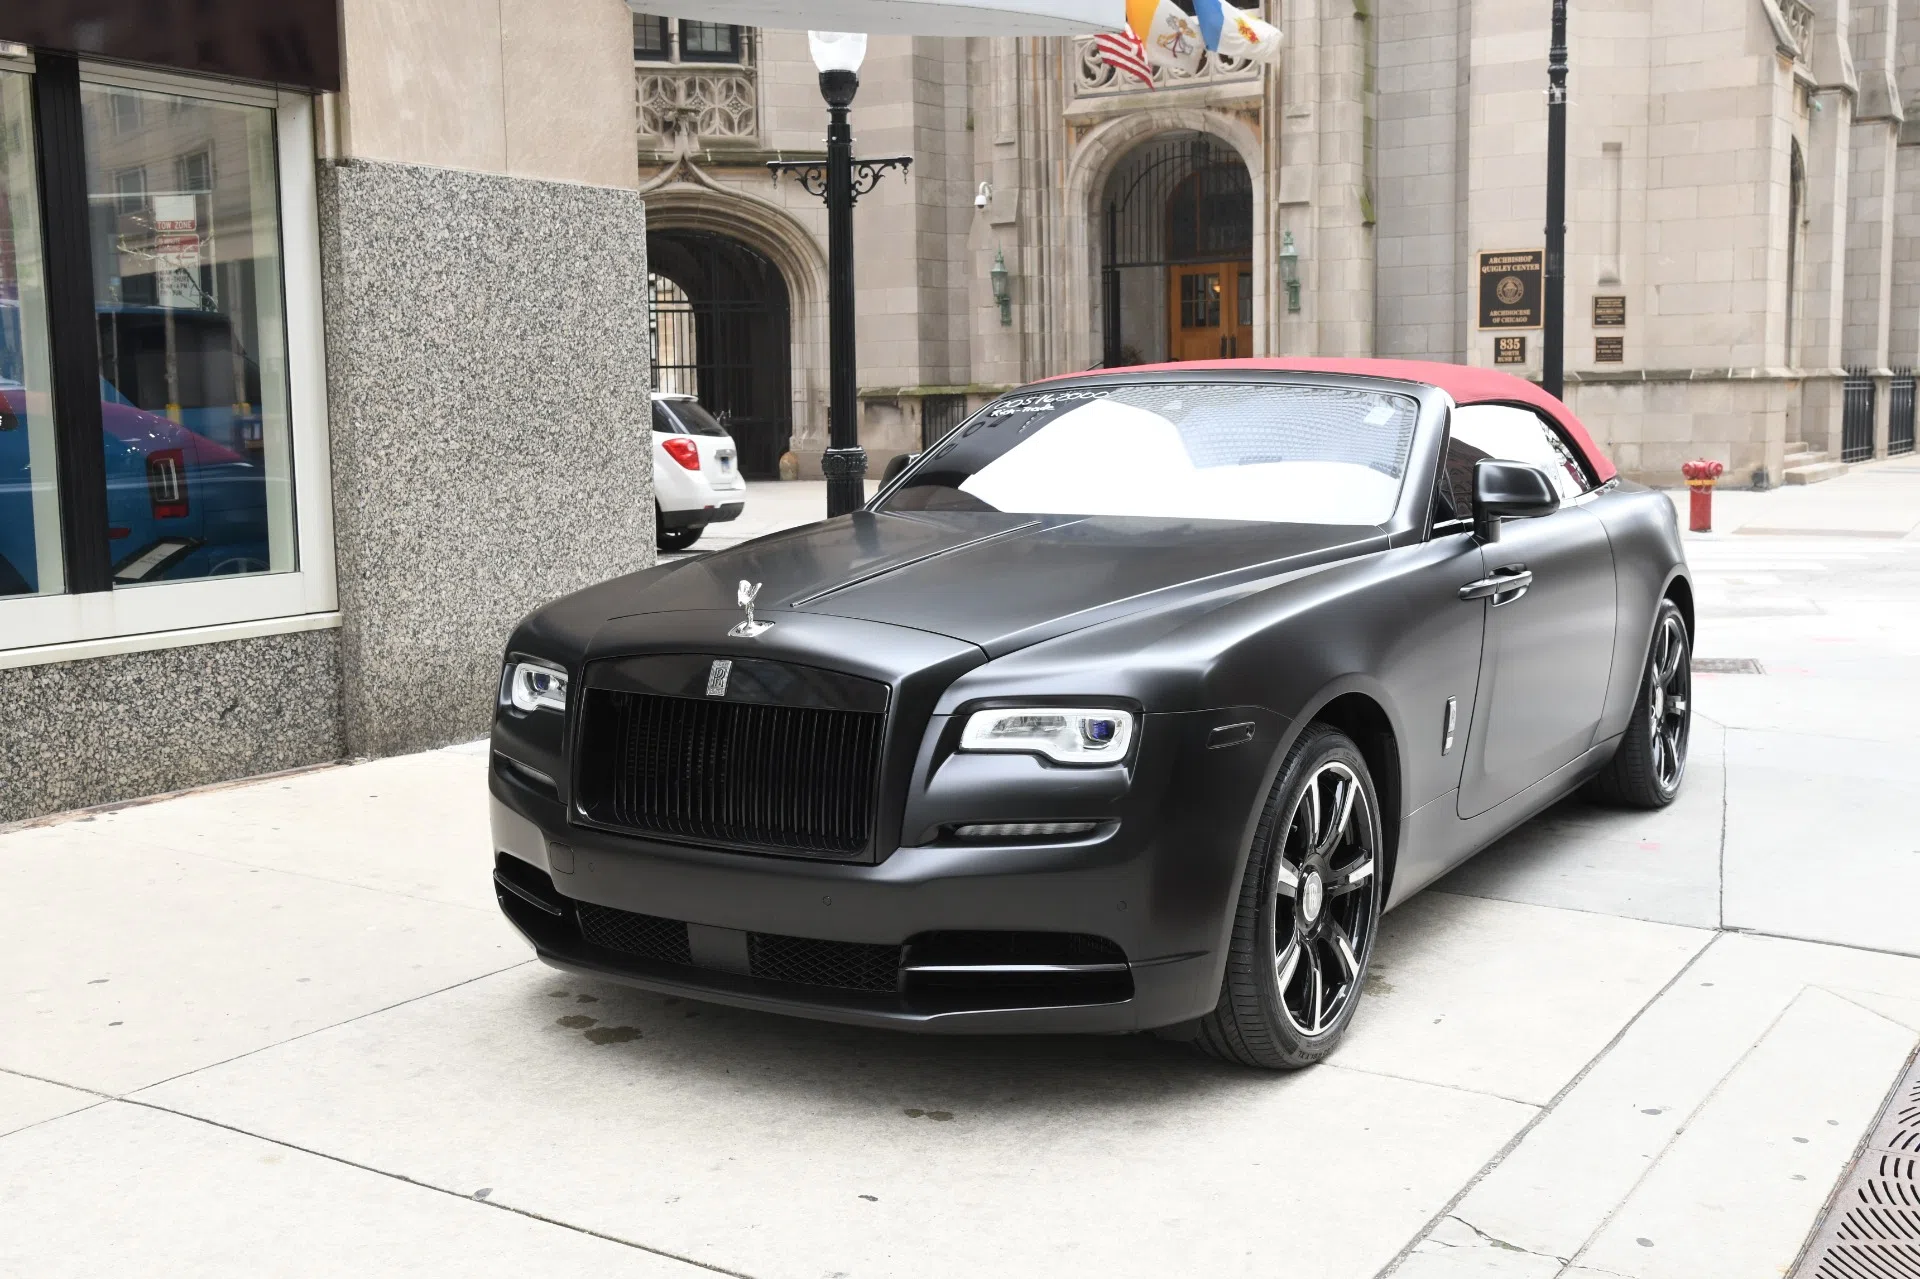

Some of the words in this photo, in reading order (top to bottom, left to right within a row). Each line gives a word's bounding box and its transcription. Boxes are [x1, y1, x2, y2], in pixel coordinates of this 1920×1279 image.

[158, 221, 171, 230] TOW
[174, 220, 192, 229] ZONE
[1489, 255, 1533, 264] ARCHBISHOP
[1481, 264, 1512, 273] QUIGLEY
[1512, 263, 1540, 271] CENTER
[1489, 308, 1531, 317] ARCHDIOCESE
[1500, 338, 1520, 350] 835
